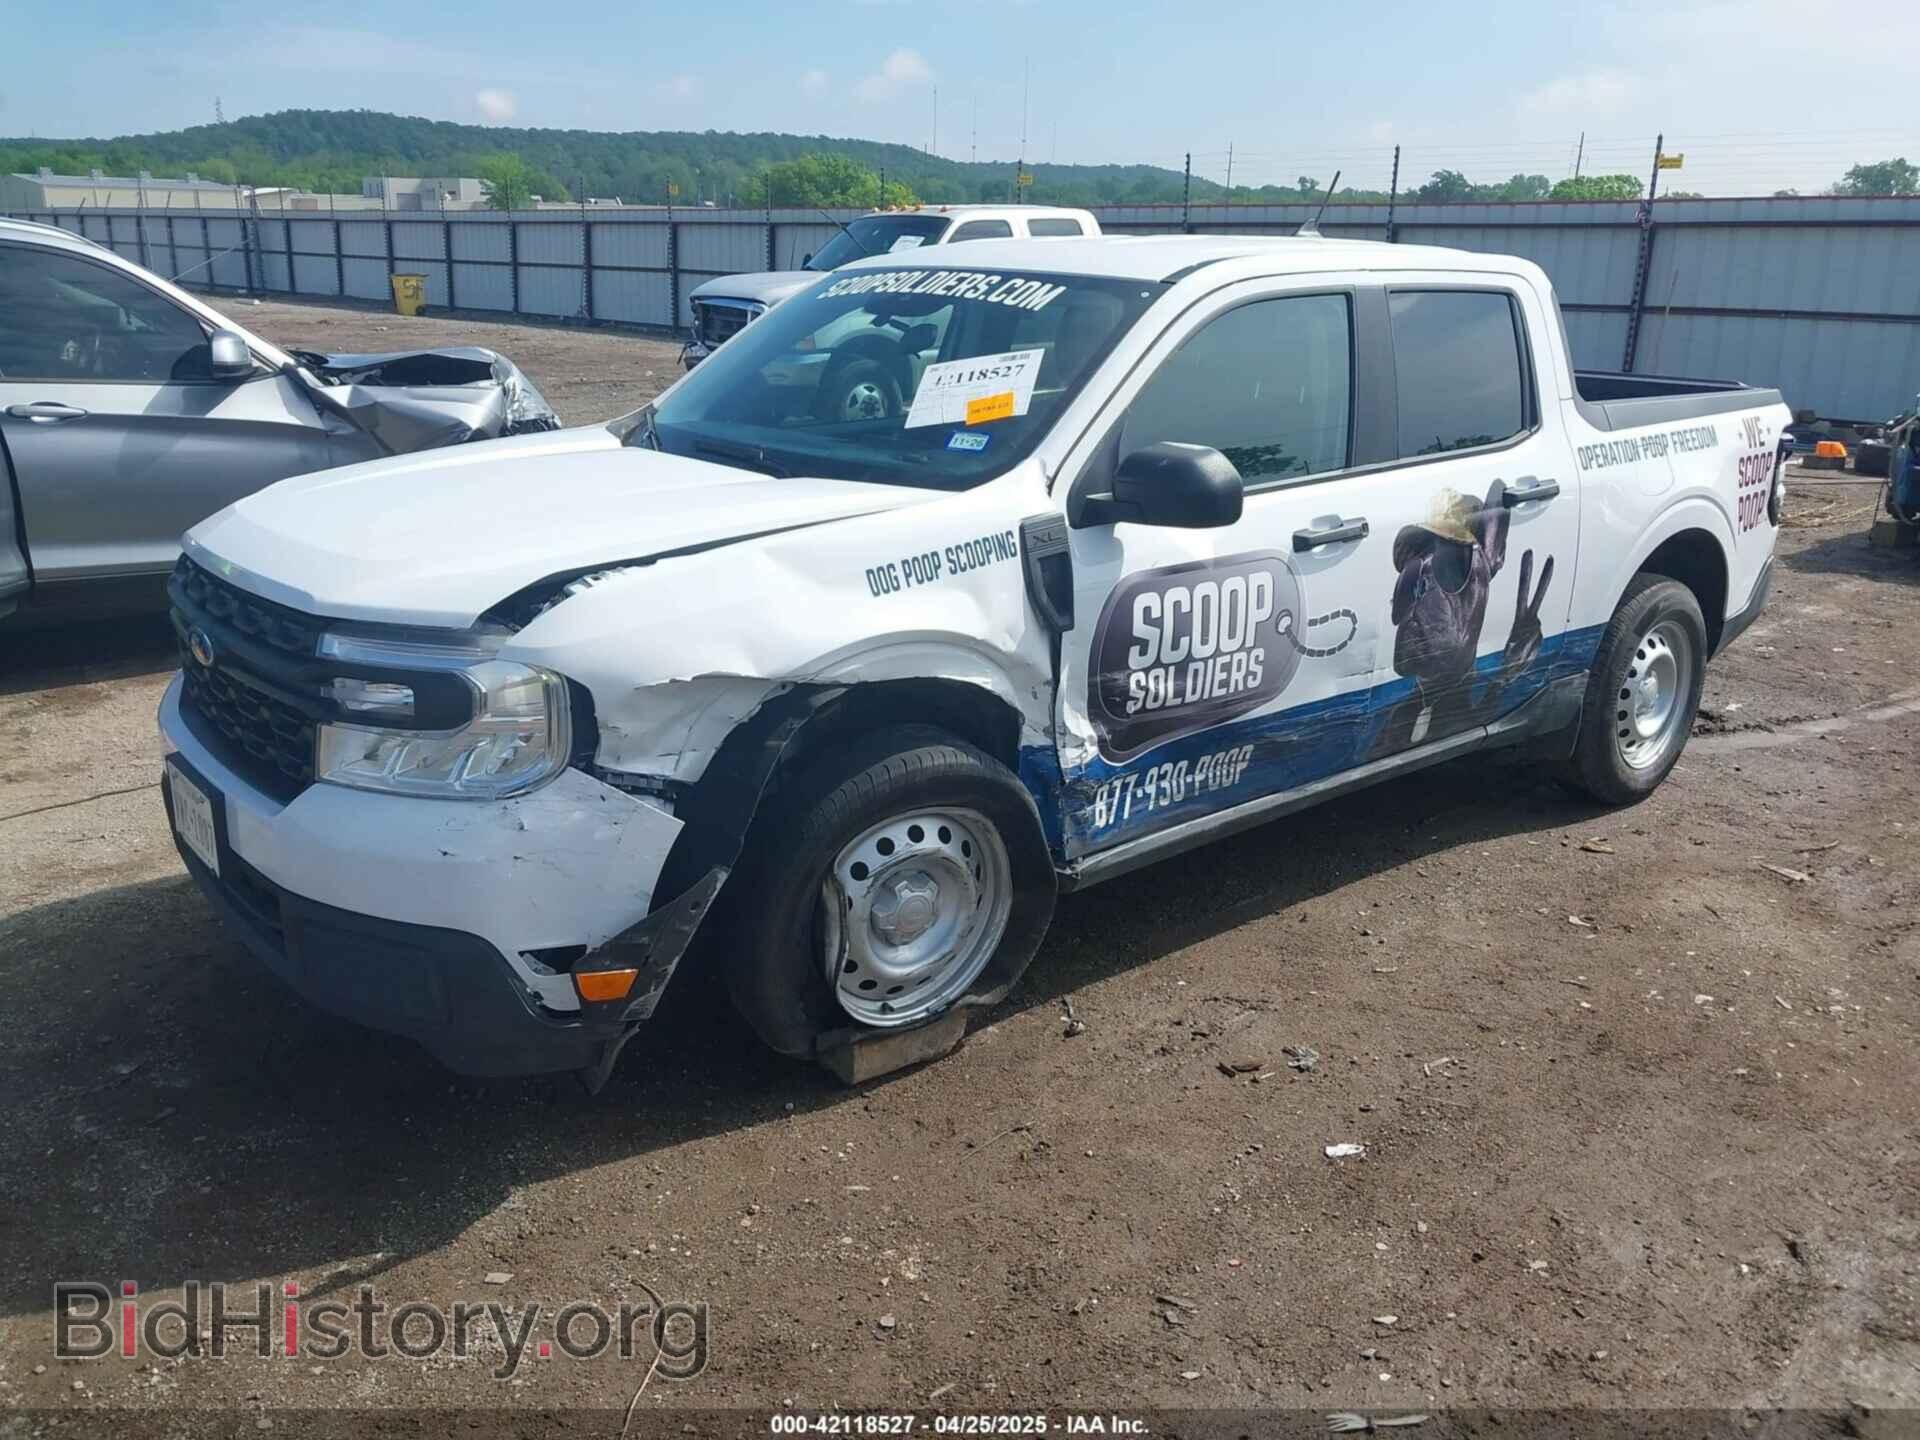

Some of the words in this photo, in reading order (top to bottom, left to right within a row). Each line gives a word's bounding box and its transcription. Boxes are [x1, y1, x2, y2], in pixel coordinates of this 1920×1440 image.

[816, 271, 1066, 311] SCOOPSOLDIERS.COM
[1577, 438, 1640, 471] OPERATION
[1640, 433, 1669, 460] POOP
[1670, 424, 1719, 454] FREEDOM
[1742, 416, 1765, 449] WE
[1738, 451, 1773, 488] SCOOP
[865, 562, 901, 597] DOG
[901, 551, 942, 588] POOP
[945, 530, 1018, 575] SCOOPING
[1128, 571, 1273, 670] SCOOP
[1126, 647, 1265, 714] SOLDIERS
